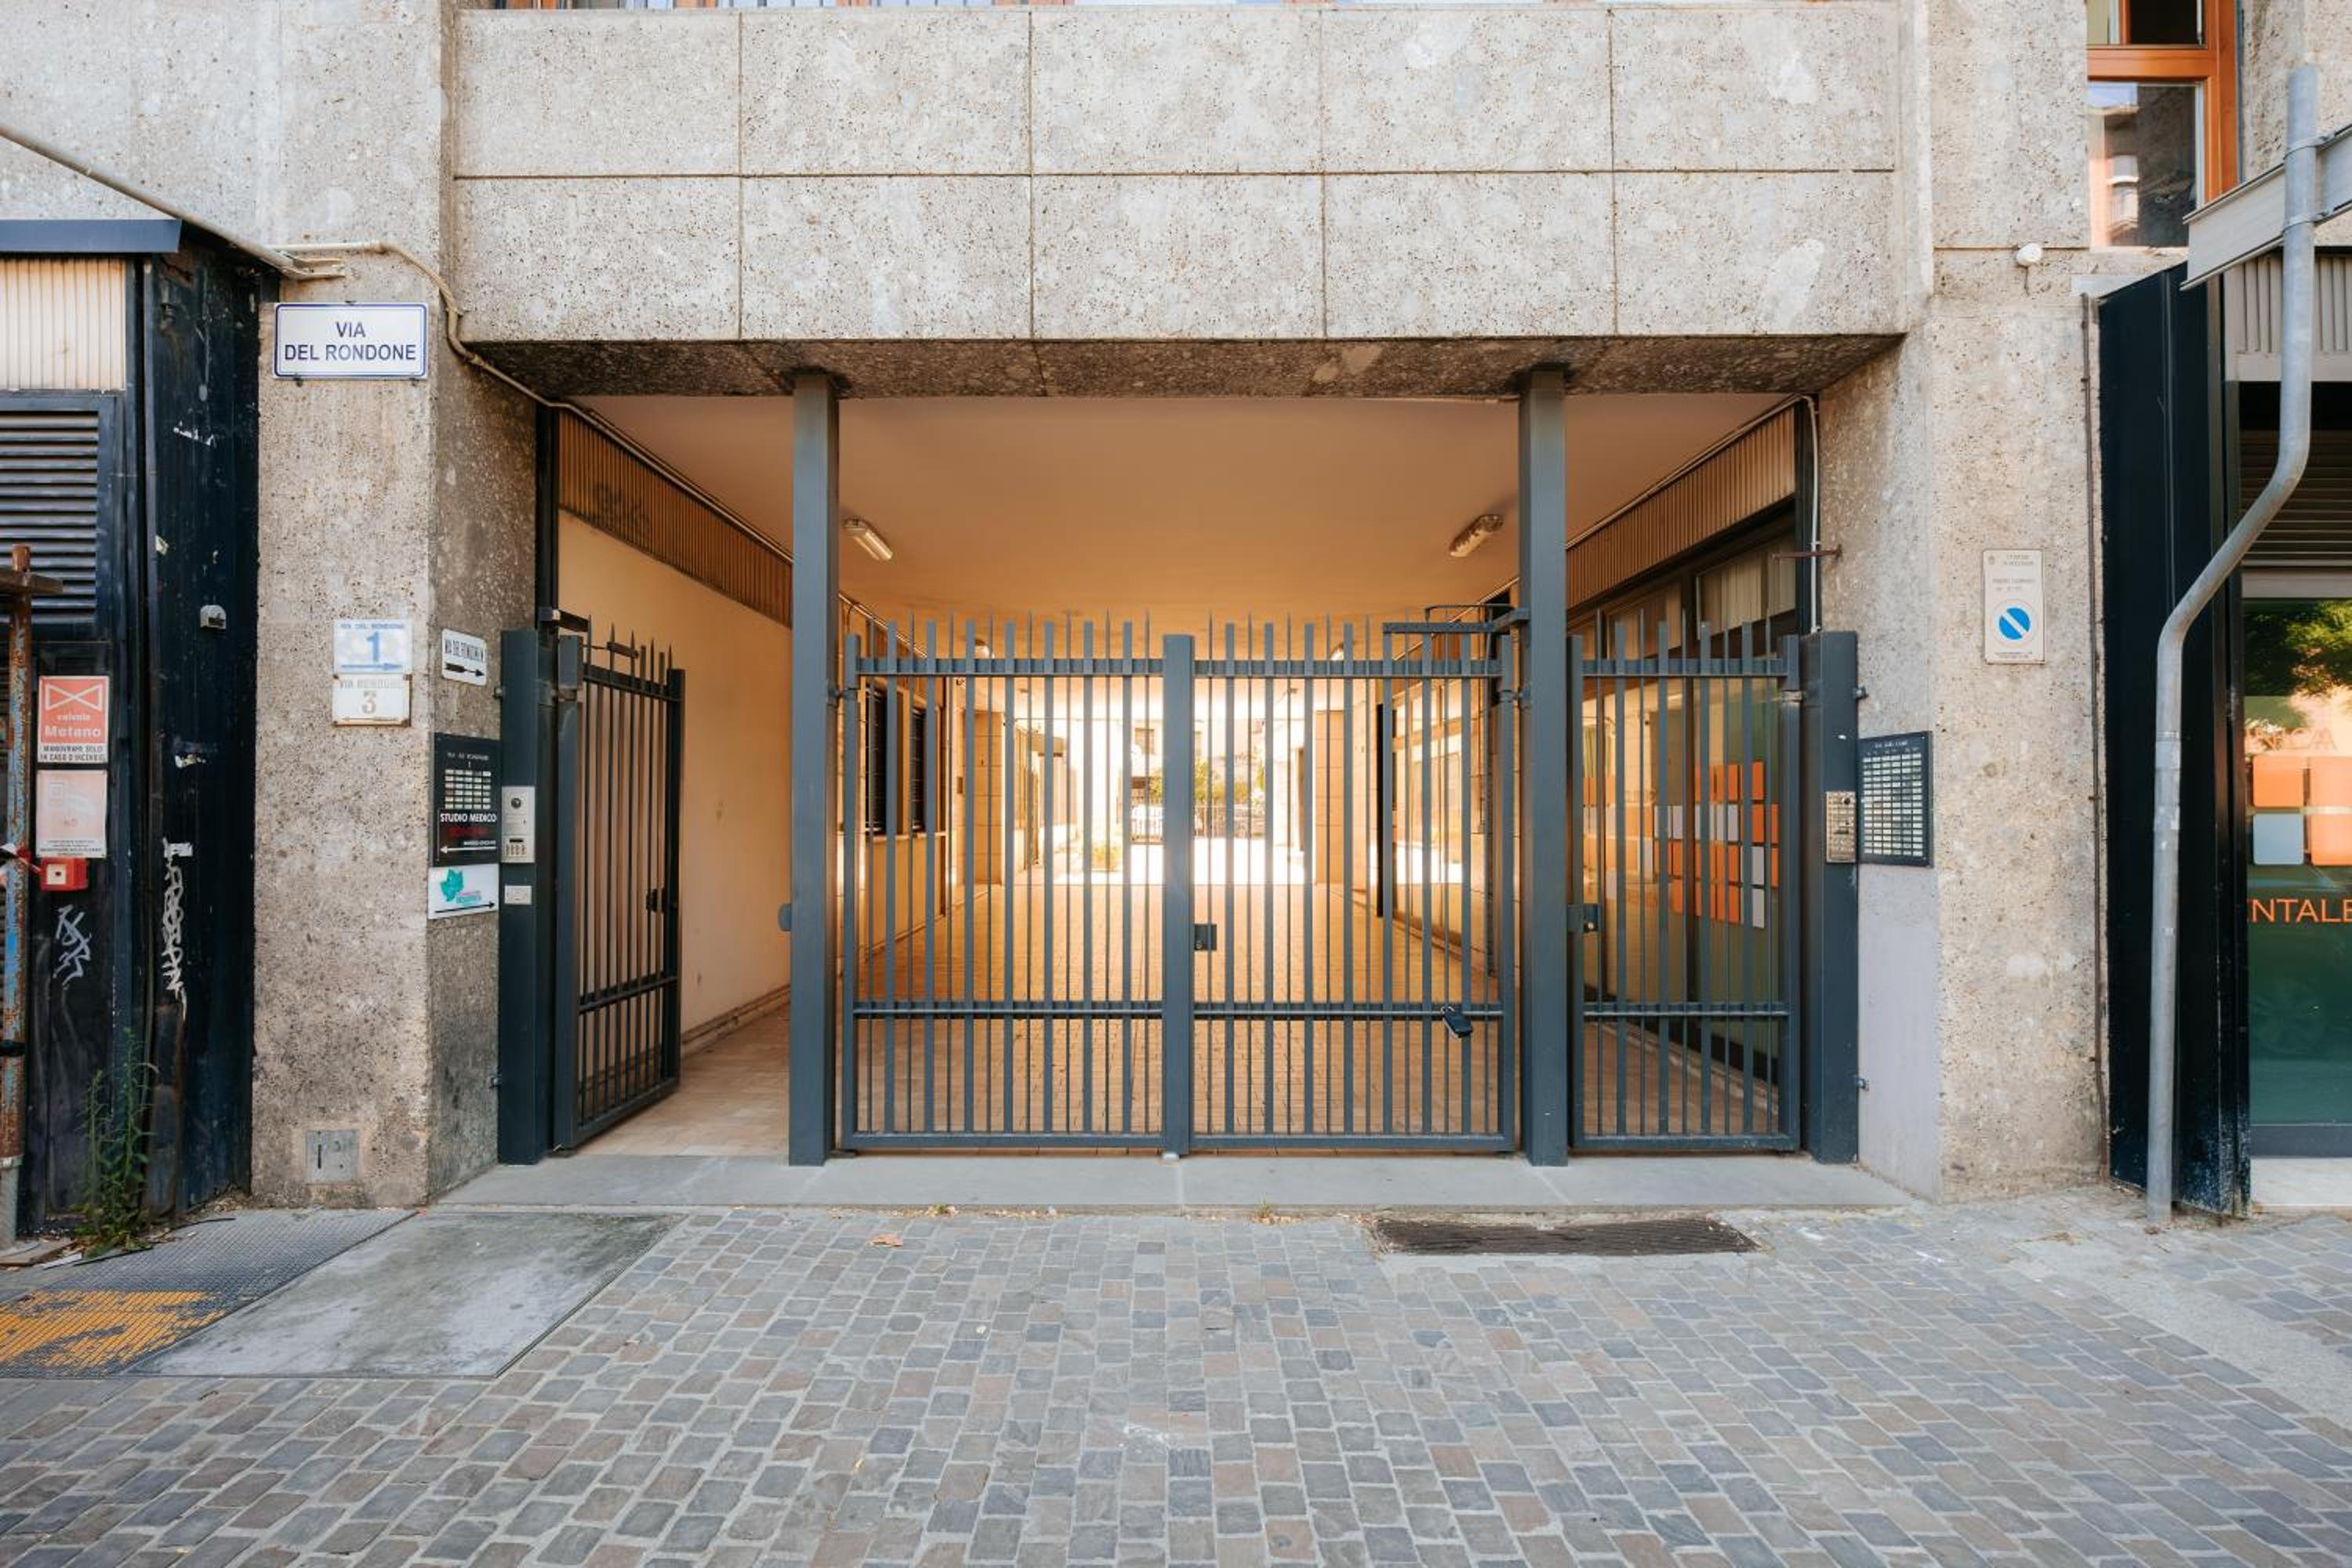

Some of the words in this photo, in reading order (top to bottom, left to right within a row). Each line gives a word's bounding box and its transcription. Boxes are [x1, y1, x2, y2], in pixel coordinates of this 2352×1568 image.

[336, 321, 366, 338] VIA
[285, 344, 319, 361] DEL
[325, 344, 417, 361] RONDONE
[365, 630, 379, 662] 1
[361, 691, 376, 714] 3
[45, 726, 101, 737] Metano
[440, 813, 468, 822] STUDIO
[470, 813, 497, 822] MEDICO
[2248, 899, 2352, 923] NTALE
